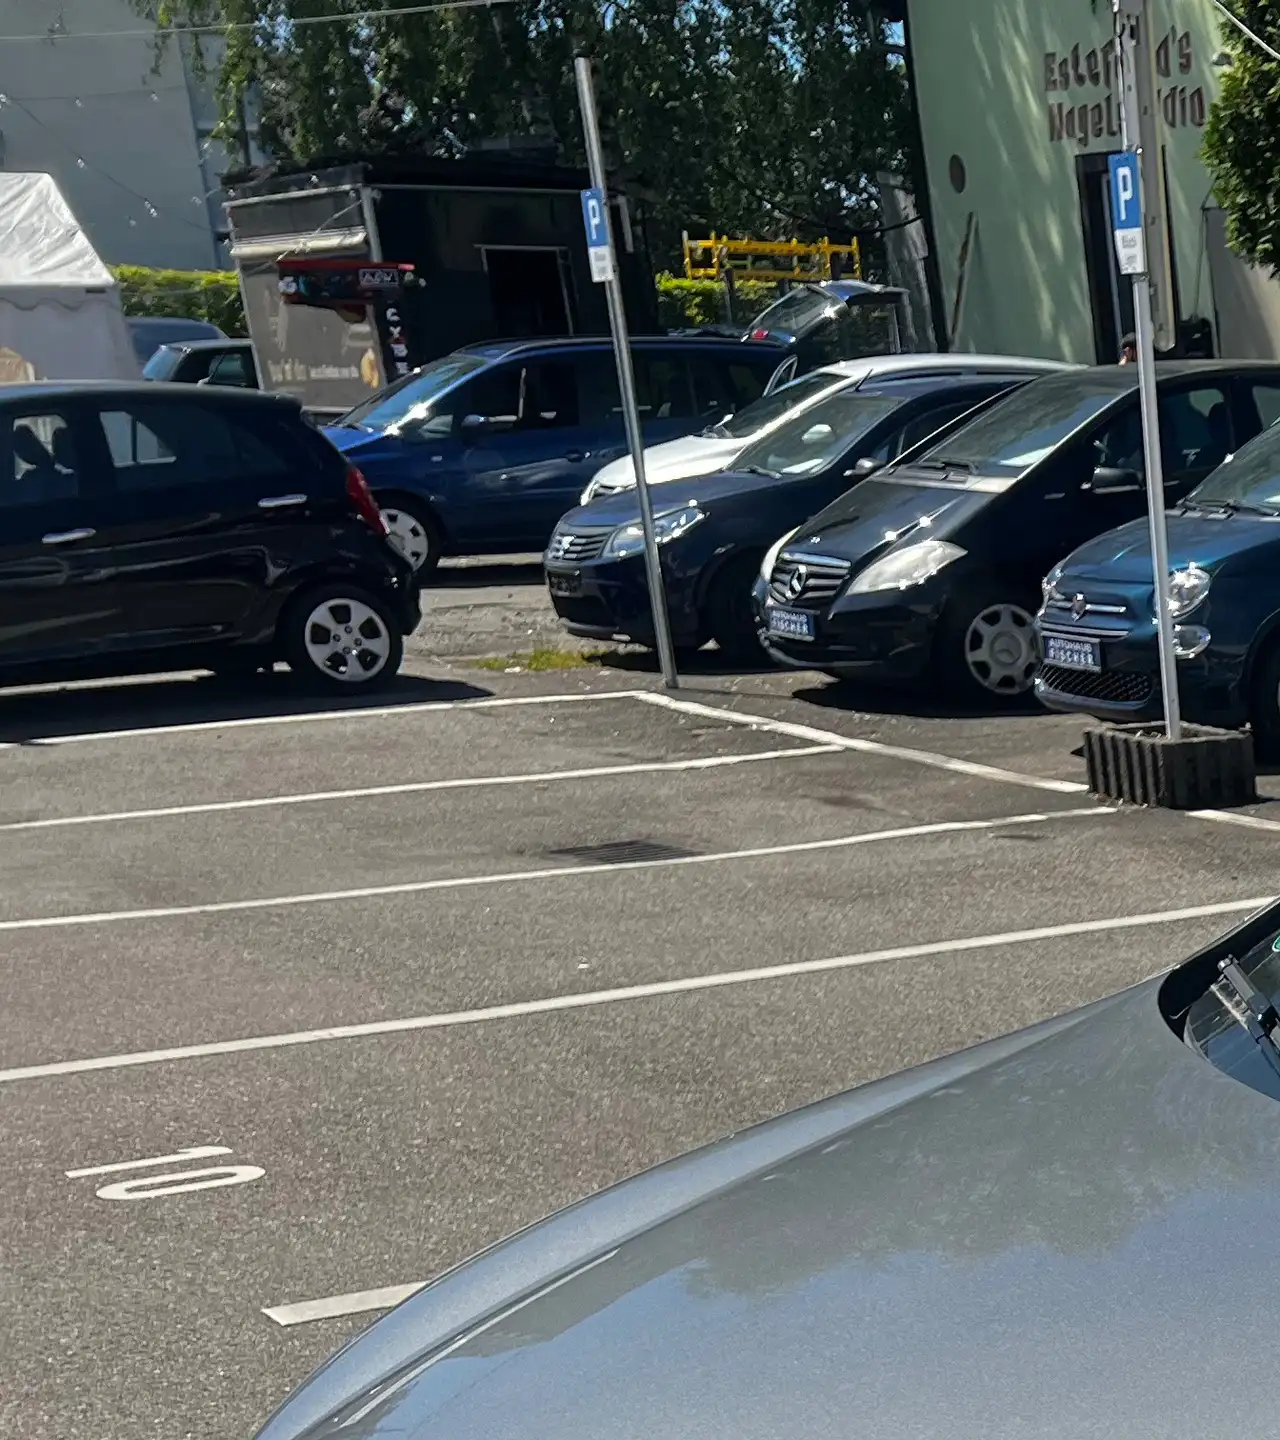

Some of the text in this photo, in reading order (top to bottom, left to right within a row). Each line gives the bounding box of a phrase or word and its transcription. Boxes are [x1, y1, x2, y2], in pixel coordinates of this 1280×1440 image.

[1116, 166, 1133, 221] P
[588, 198, 601, 240] P
[1049, 647, 1095, 665] FISCHER
[64, 1145, 267, 1201] 10
